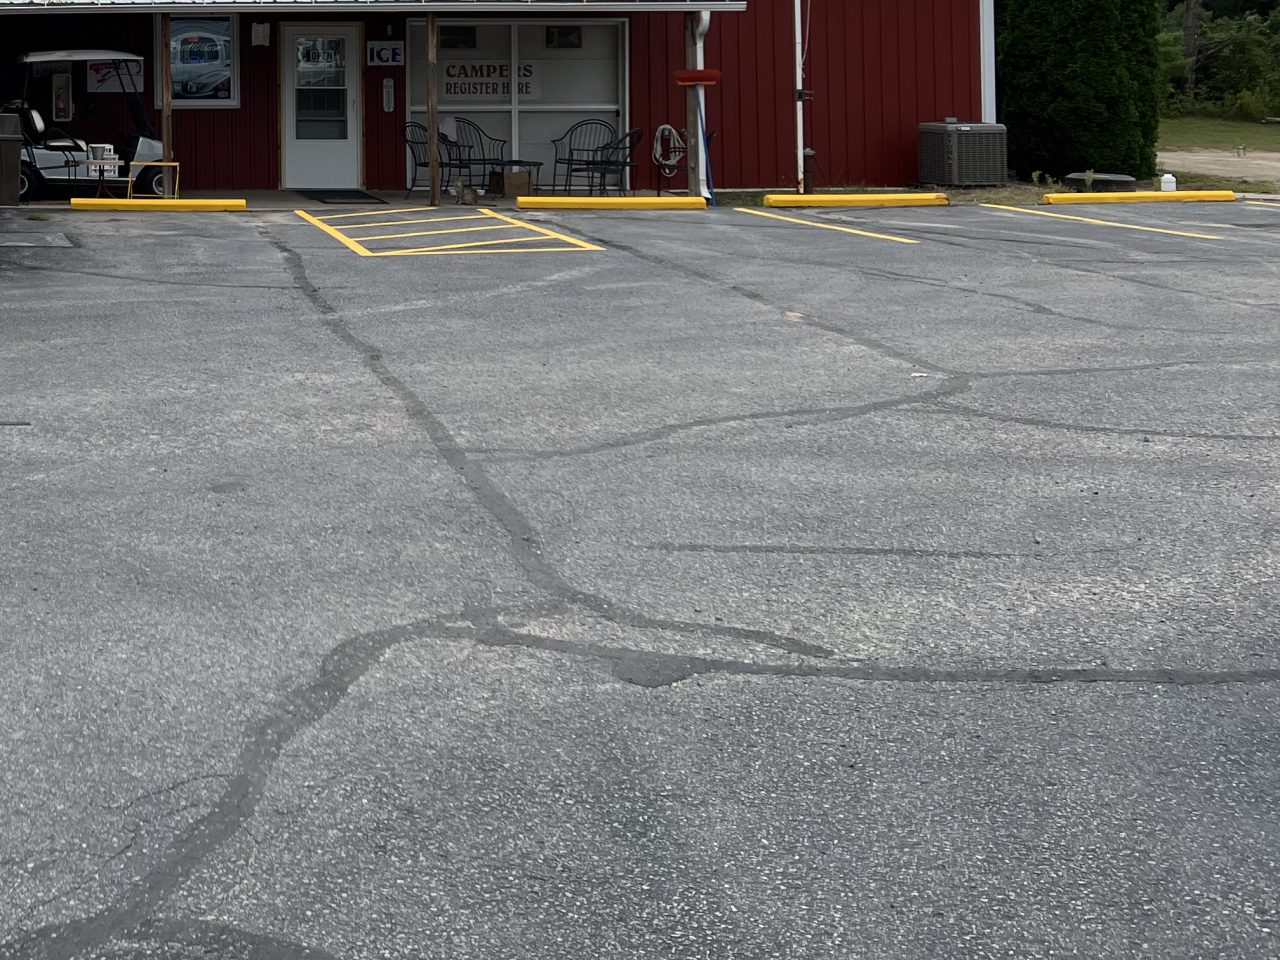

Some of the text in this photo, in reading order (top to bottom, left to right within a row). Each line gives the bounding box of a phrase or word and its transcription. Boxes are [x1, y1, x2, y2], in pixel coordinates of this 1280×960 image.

[311, 50, 333, 61] OPEN
[369, 47, 401, 63] ICE
[446, 82, 531, 95] REGISTER HRE
